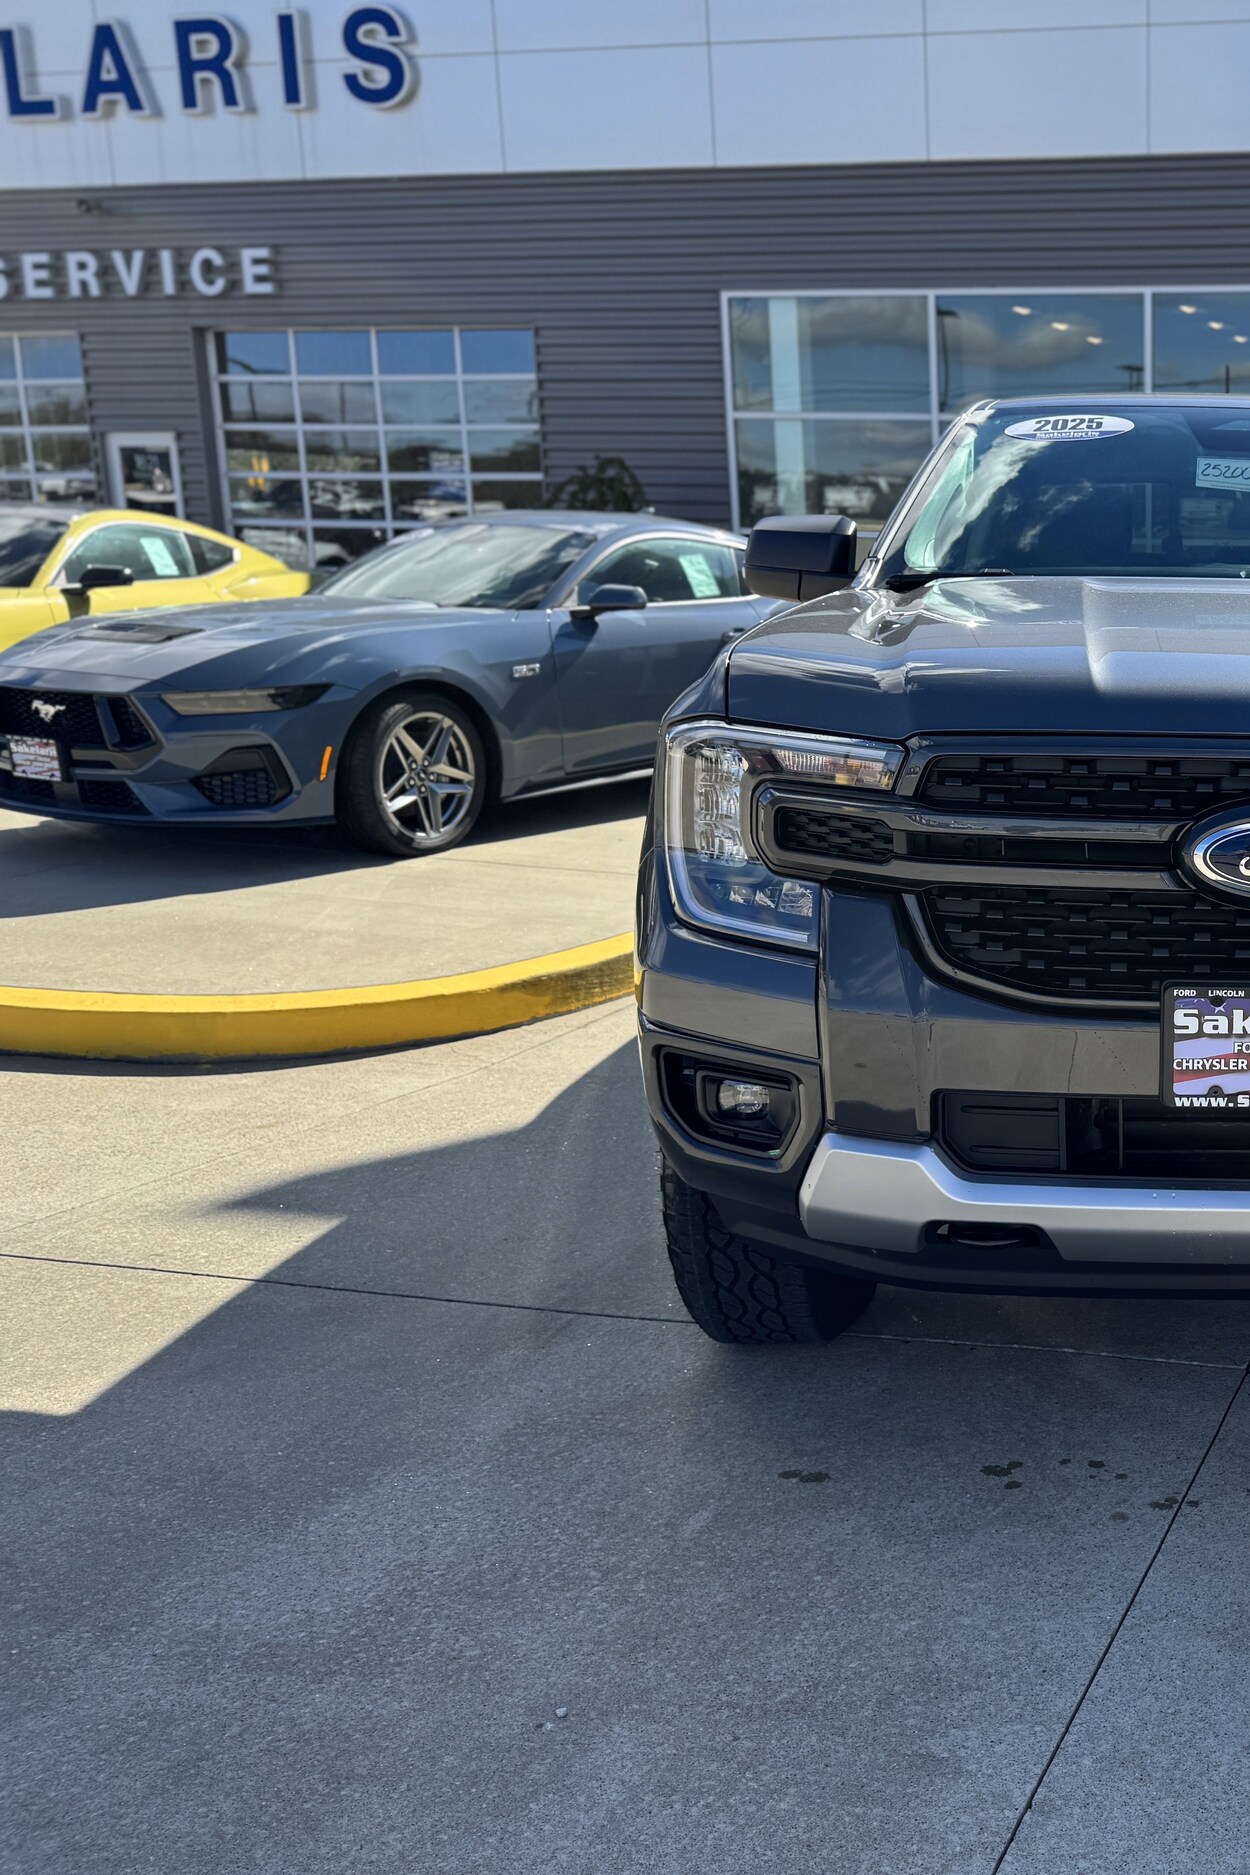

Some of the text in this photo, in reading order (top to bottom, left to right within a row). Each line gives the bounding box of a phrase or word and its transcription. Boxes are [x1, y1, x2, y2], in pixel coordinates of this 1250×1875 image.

[0, 247, 275, 299] ERVICE
[1033, 417, 1104, 432] 2025
[1173, 989, 1197, 997] FORD
[1208, 989, 1245, 998] LINCOLN
[1173, 1058, 1248, 1071] CHRYSLER
